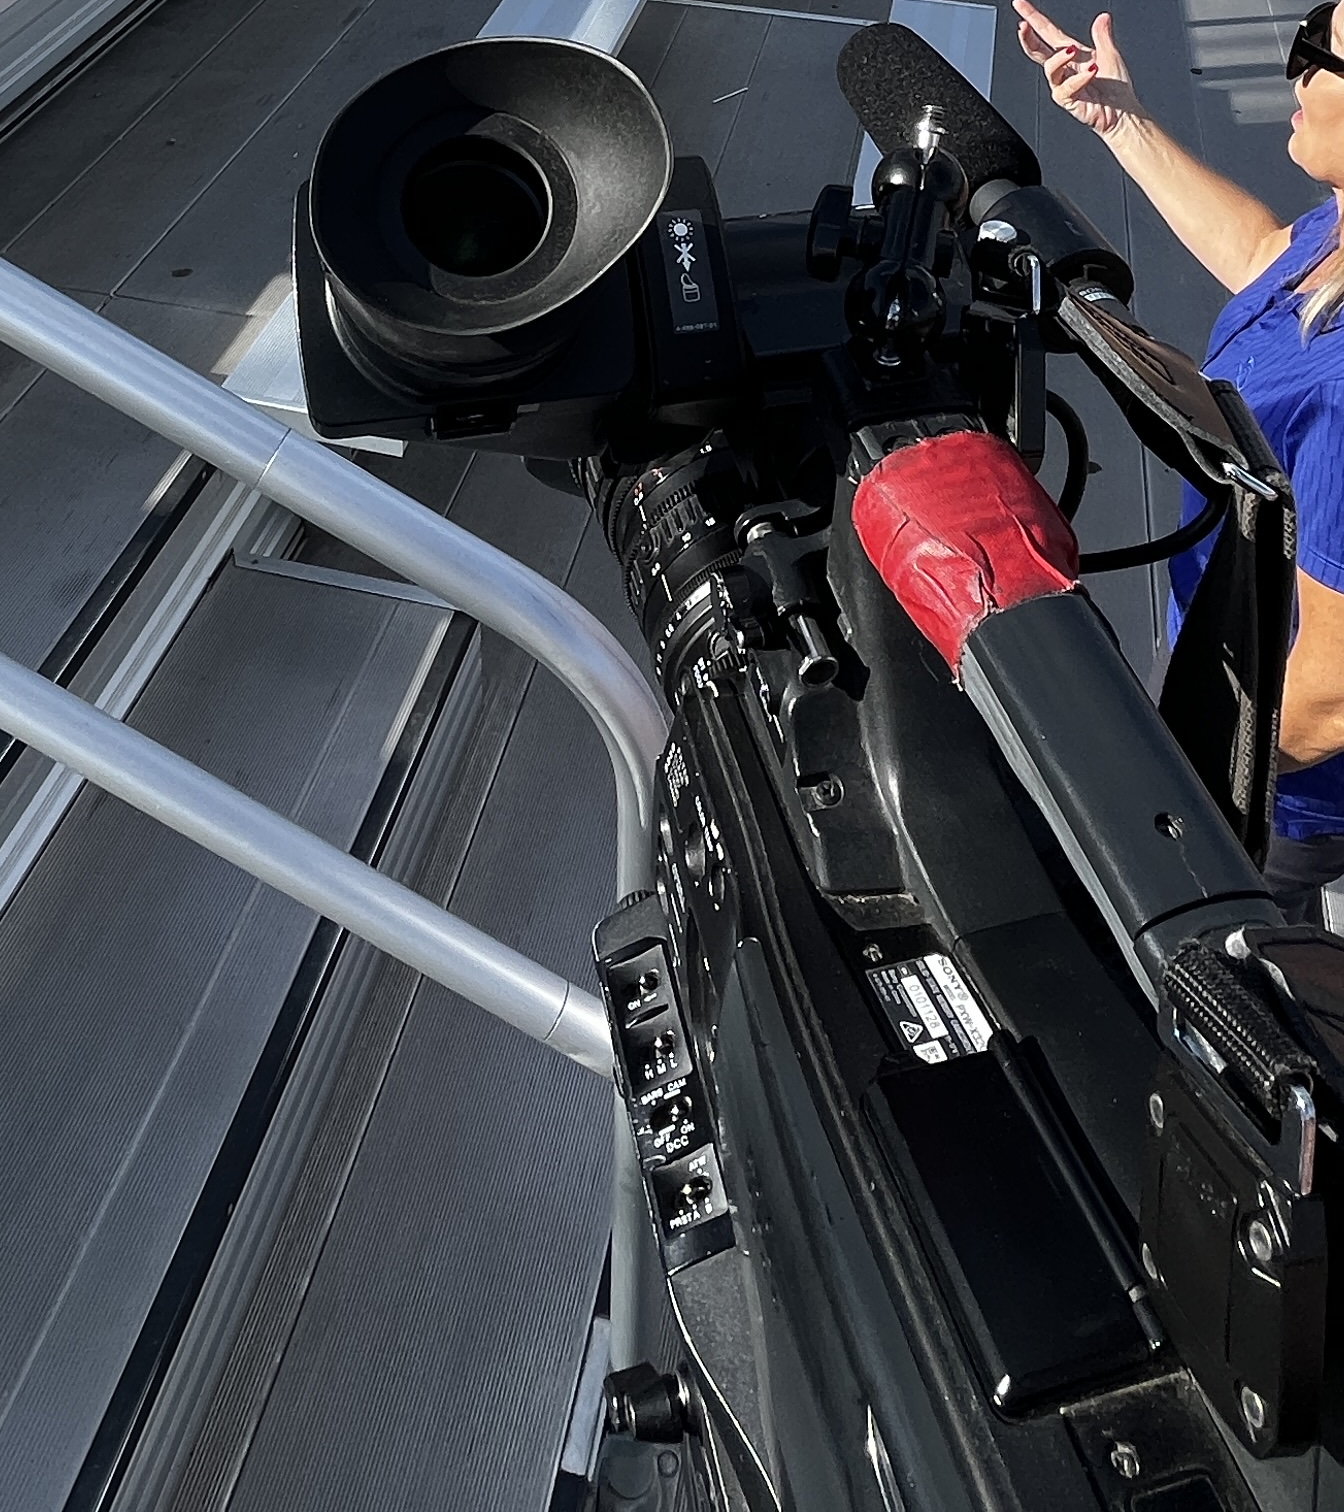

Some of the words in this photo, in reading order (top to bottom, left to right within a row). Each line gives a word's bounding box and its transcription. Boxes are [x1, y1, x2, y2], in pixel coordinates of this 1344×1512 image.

[627, 999, 642, 1011] ON
[909, 984, 941, 1029] 0101128
[667, 1078, 687, 1092] CAM
[680, 1122, 695, 1134] ON
[666, 1135, 689, 1154] DCC
